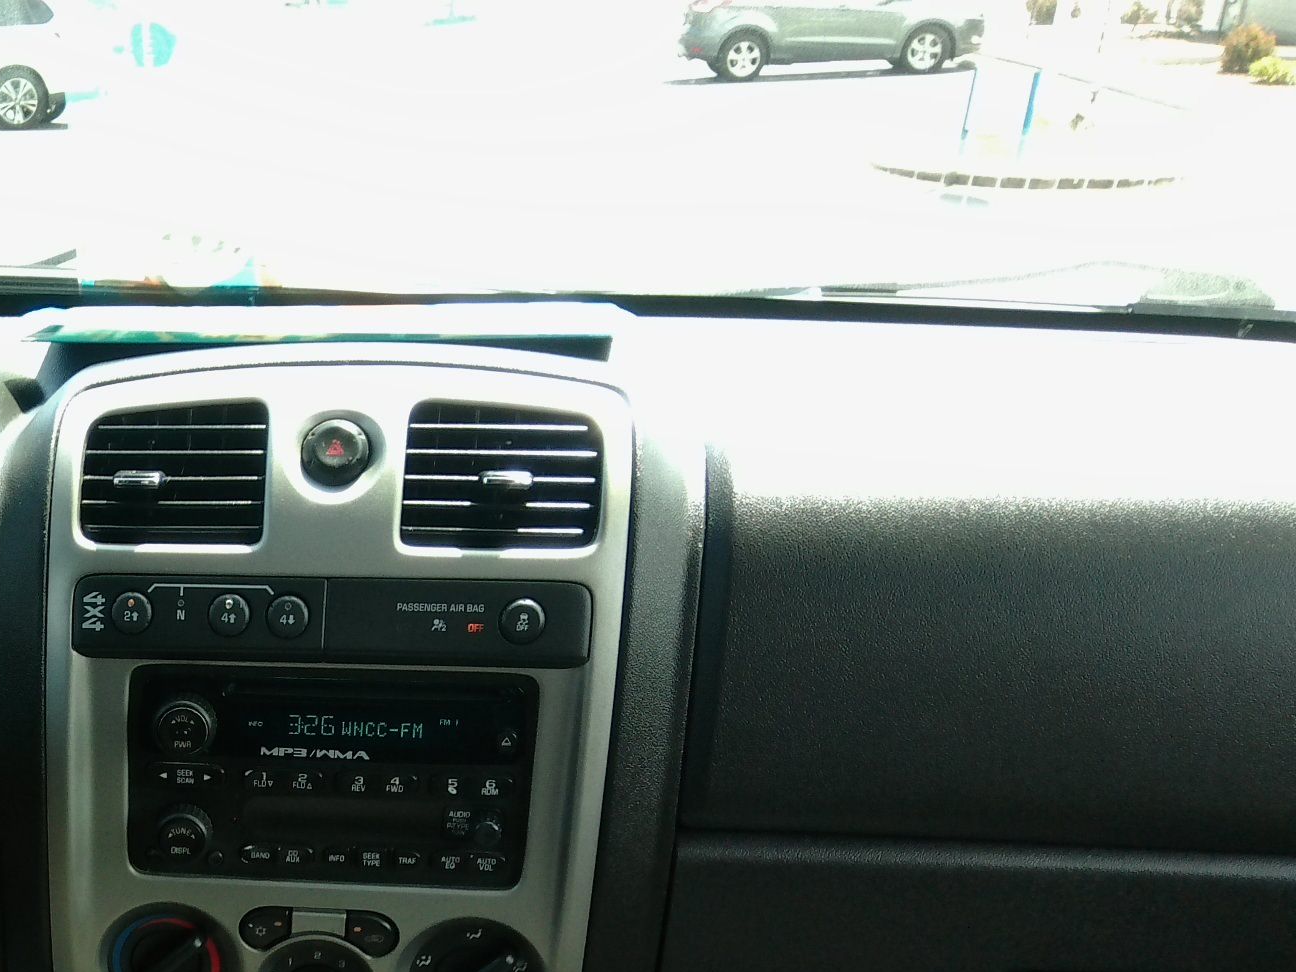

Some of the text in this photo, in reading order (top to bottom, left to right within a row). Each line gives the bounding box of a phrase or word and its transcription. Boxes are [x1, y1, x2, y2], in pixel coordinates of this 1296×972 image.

[396, 602, 485, 613] PASSENGER AIR BAG
[176, 609, 186, 621] N
[467, 623, 485, 633] OFF
[175, 714, 190, 723] VOL
[341, 721, 424, 739] WNCC-FM
[174, 740, 192, 749] PWR
[176, 769, 194, 777] SEEK
[176, 777, 195, 785] SCAN
[297, 773, 308, 783] 2
[354, 776, 364, 785] 3
[390, 776, 400, 785] 4
[447, 778, 458, 787] 5
[351, 784, 367, 792] REV
[485, 779, 496, 788] 6
[385, 785, 404, 793] FWD
[481, 788, 499, 796] RDM
[448, 810, 471, 819] AUDIO
[171, 827, 192, 837] TUNE
[170, 846, 192, 855] DISPL
[250, 851, 271, 860] BAND
[285, 855, 301, 864] AUX
[328, 854, 345, 863] INFO
[362, 852, 381, 860] SEEK
[441, 856, 461, 864] AUTO
[362, 859, 381, 867] TYPE
[476, 857, 497, 866] AUTO
[479, 864, 494, 872] VOL
